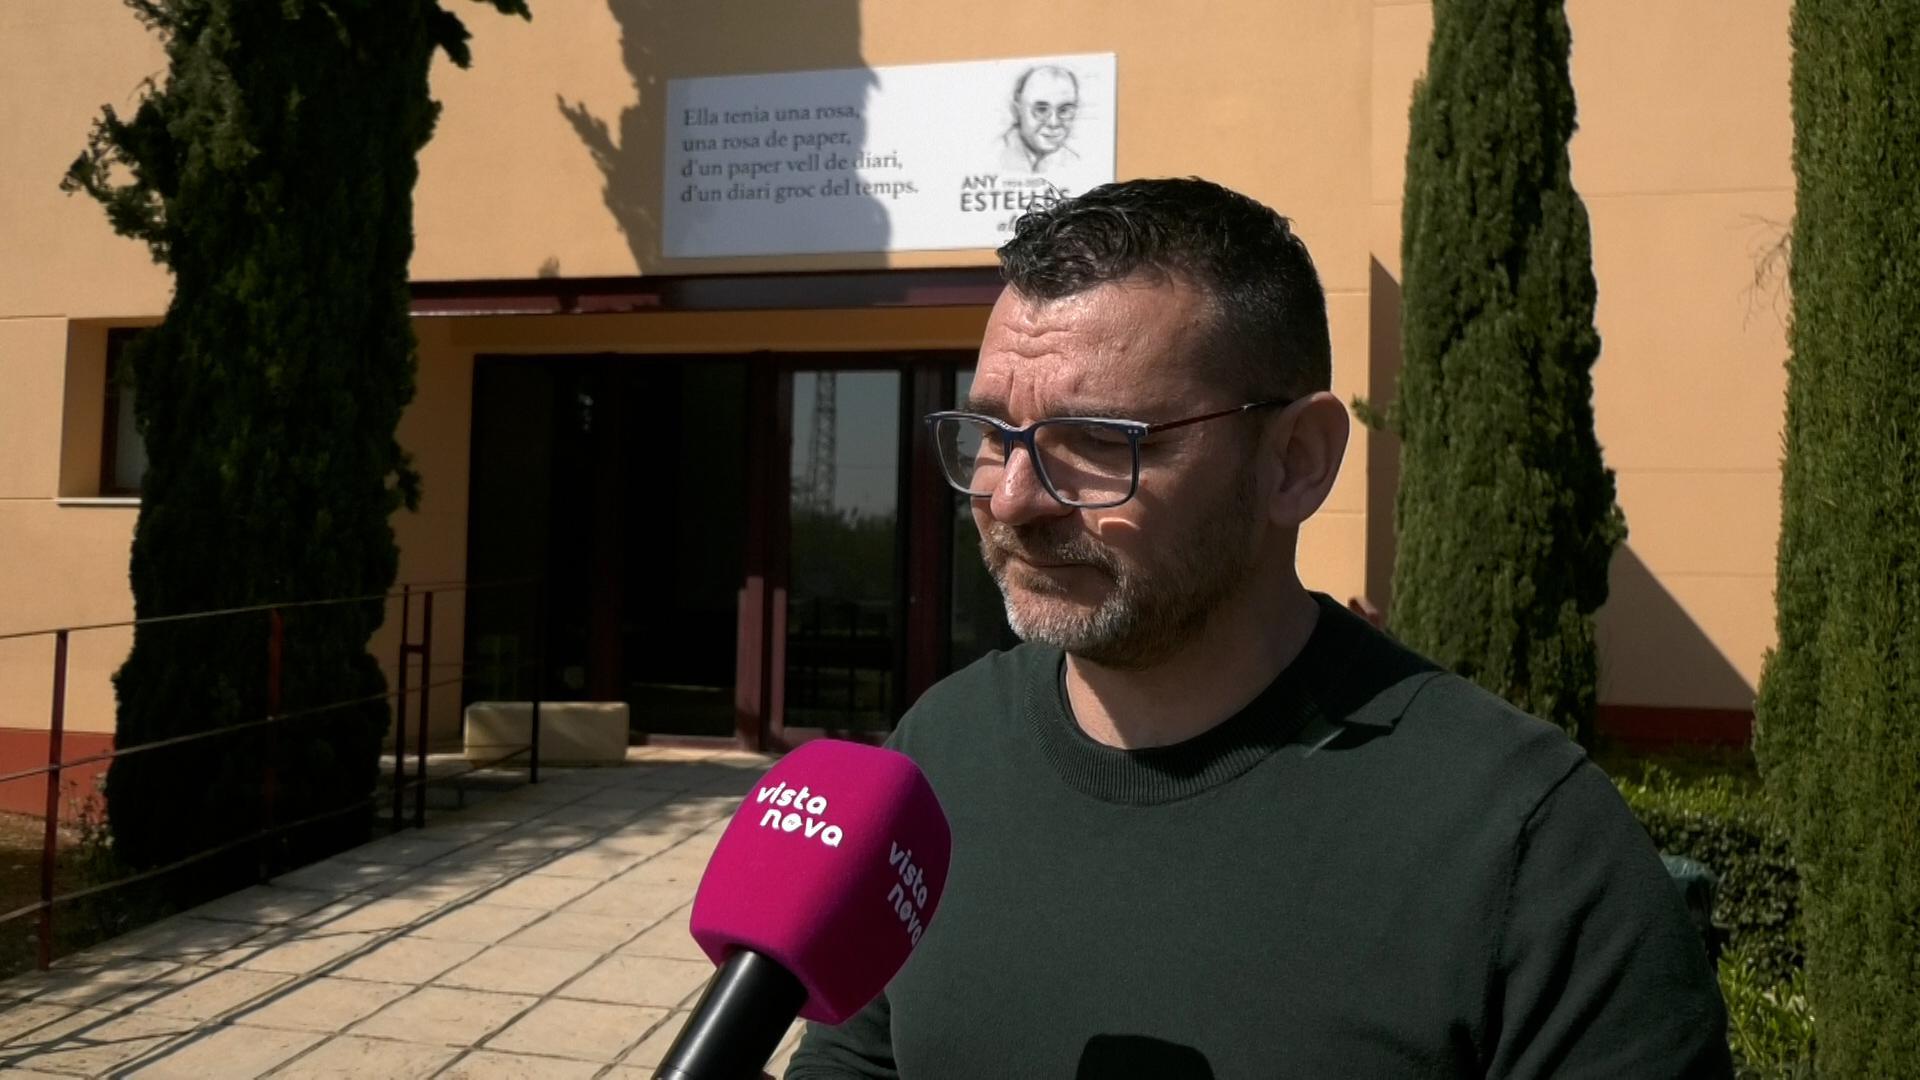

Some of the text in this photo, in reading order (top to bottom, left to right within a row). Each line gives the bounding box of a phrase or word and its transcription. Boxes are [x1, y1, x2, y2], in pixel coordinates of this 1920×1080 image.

[683, 105, 861, 126] Ella tenia una rosa,
[682, 130, 852, 152] una rosa de paper,
[727, 159, 782, 179] paper
[786, 153, 820, 172] vell
[824, 153, 849, 170] de
[852, 151, 903, 170] diari,
[726, 183, 770, 201] diari
[774, 185, 816, 203] groc
[820, 179, 850, 197] del
[853, 180, 920, 199] temps.
[962, 175, 998, 189] ANY
[756, 781, 827, 815] vista
[760, 808, 843, 848] nova
[889, 840, 928, 909] vista
[887, 883, 923, 948] nova
